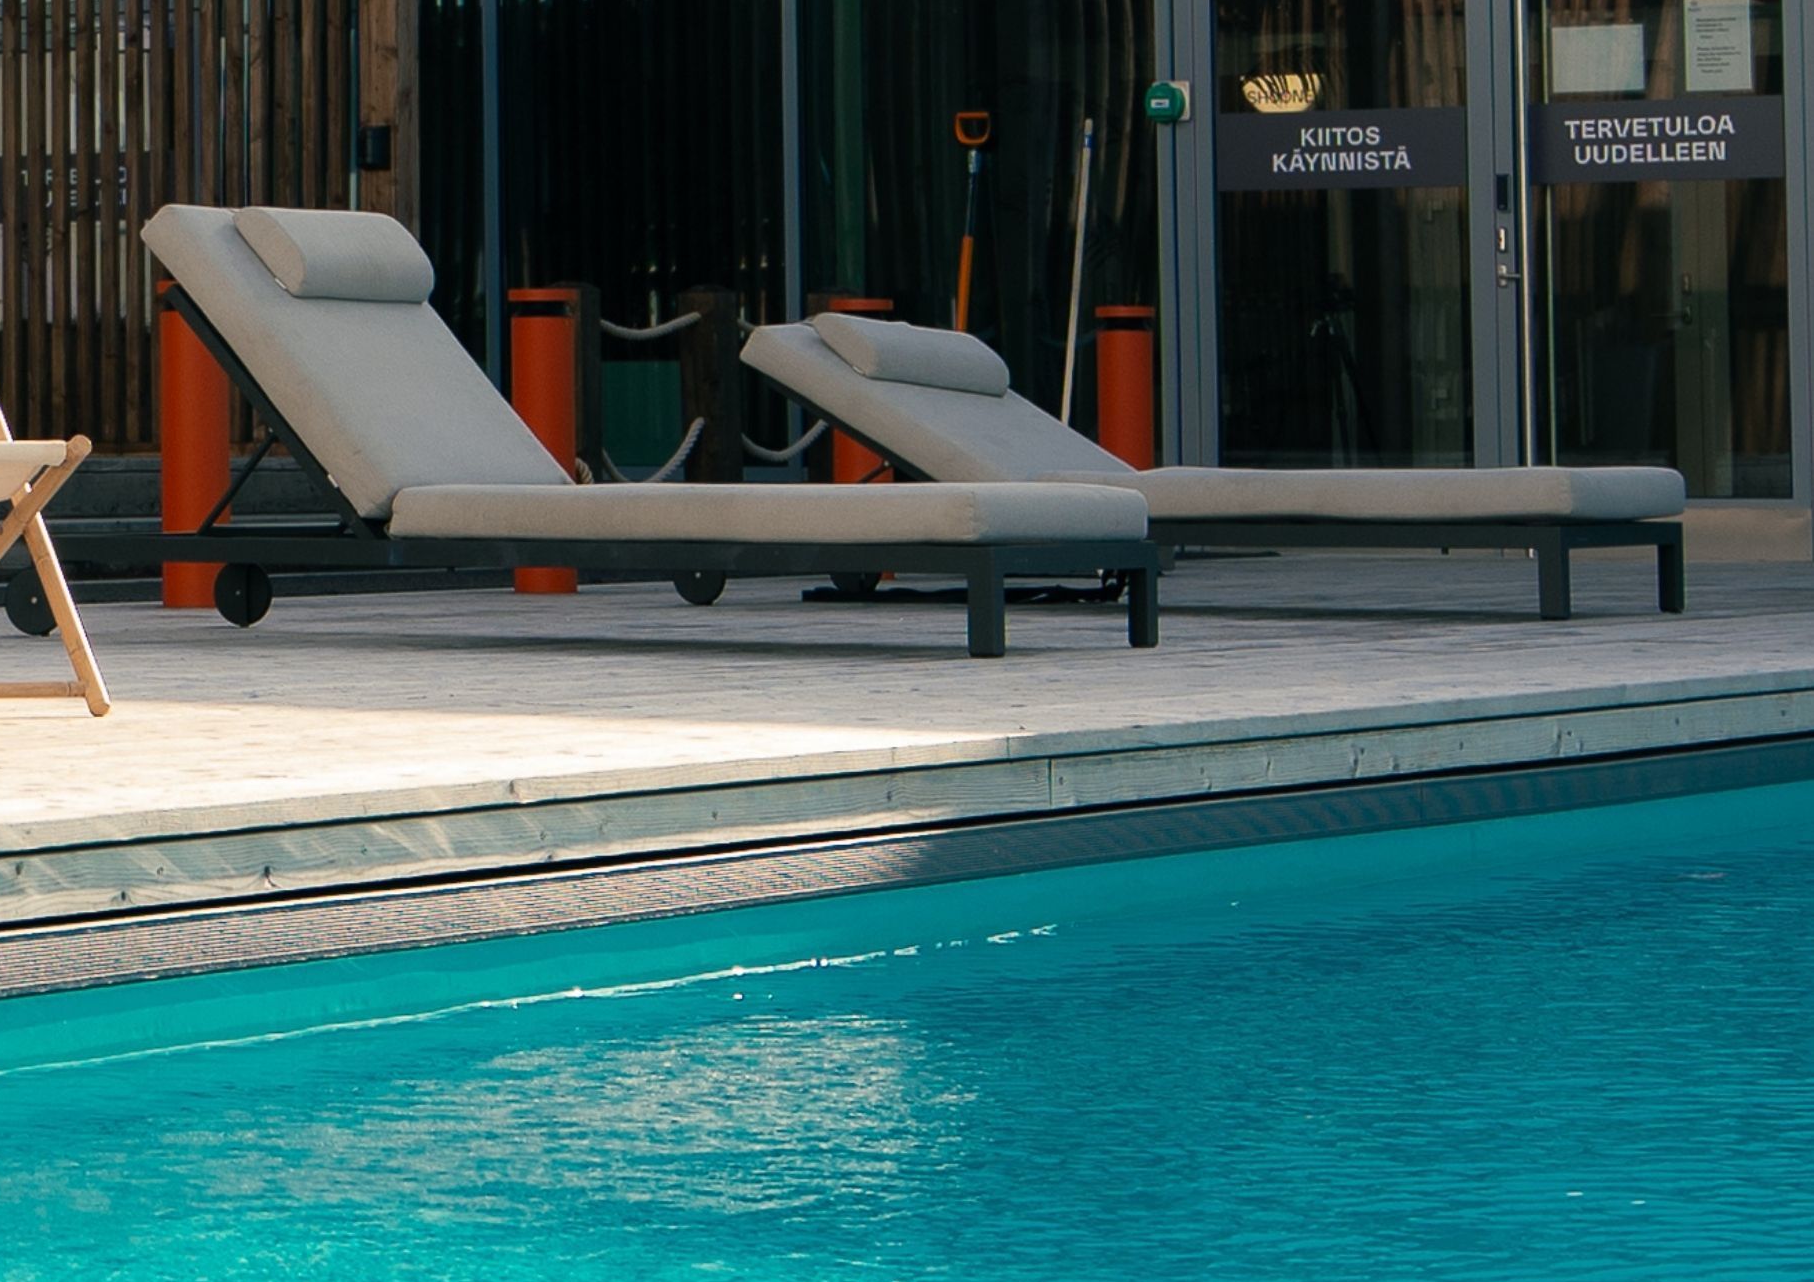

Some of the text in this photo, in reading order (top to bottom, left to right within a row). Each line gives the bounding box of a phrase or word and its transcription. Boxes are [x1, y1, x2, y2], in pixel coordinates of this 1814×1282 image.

[1300, 126, 1381, 147] KIITOS
[1564, 115, 1736, 140] TERVETULOA
[1272, 145, 1412, 173] KÄYNNISTÄ
[1574, 141, 1726, 165] UUDELLEEN
